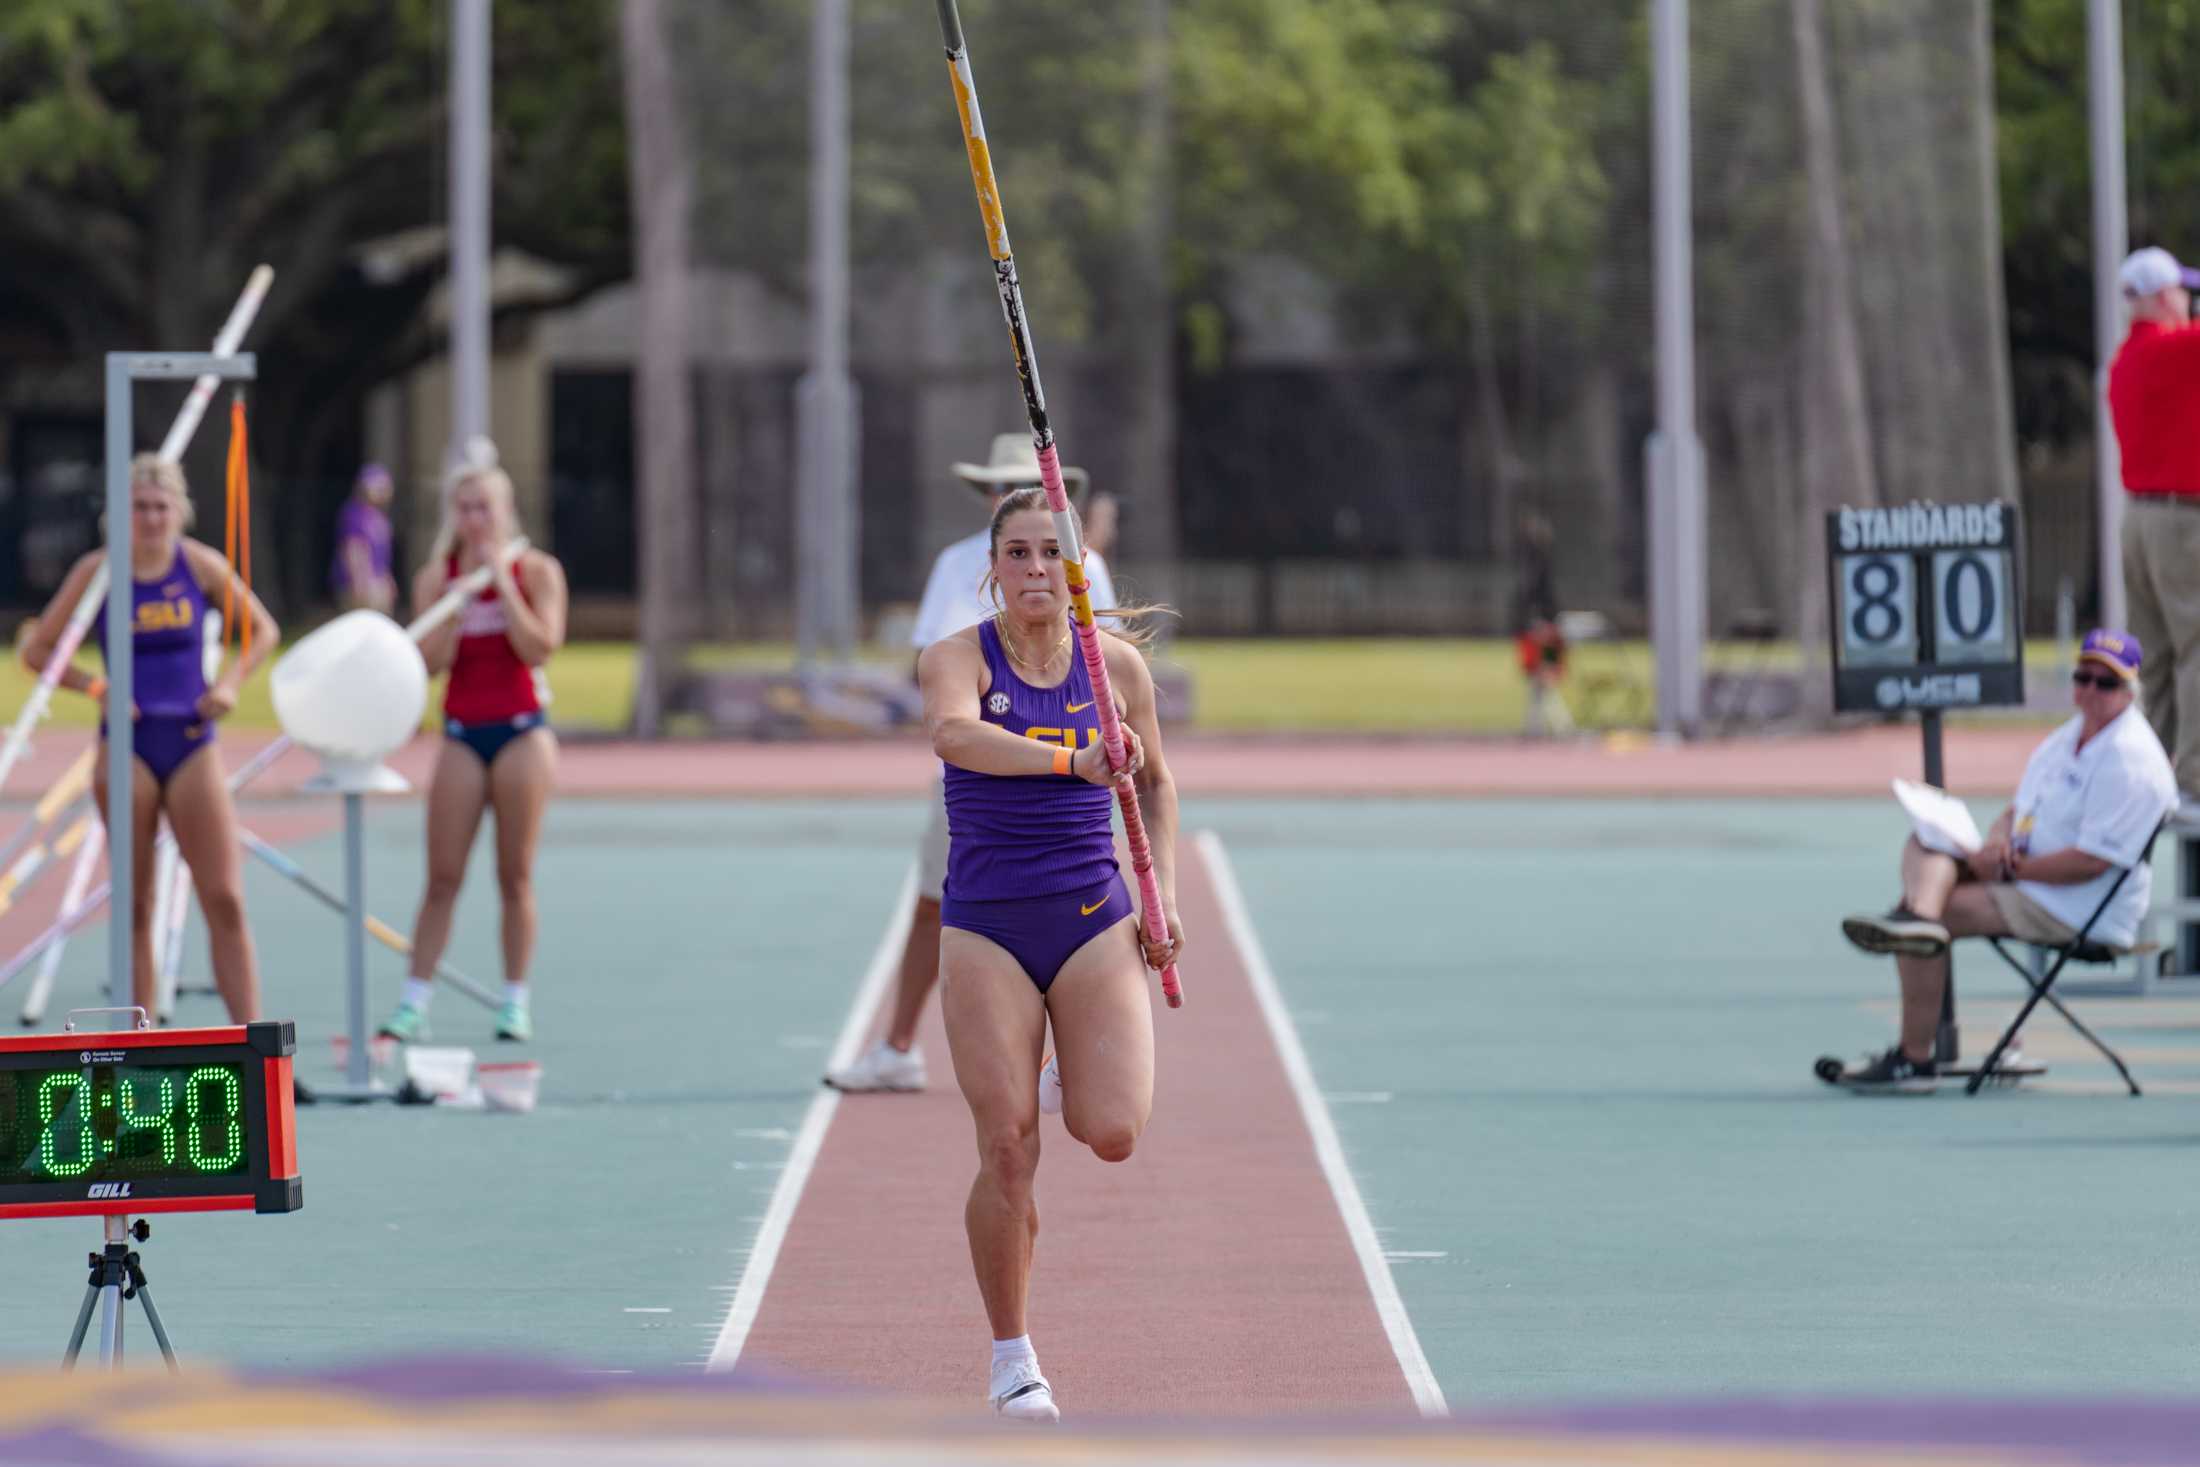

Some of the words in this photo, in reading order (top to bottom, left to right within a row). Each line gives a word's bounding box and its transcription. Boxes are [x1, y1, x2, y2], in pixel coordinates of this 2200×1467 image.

[1839, 499, 2003, 549] STANDARDS
[131, 597, 193, 632] SU
[989, 693, 1010, 714] SEC
[39, 1067, 240, 1175] 0:40
[87, 1182, 131, 1199] GILL
